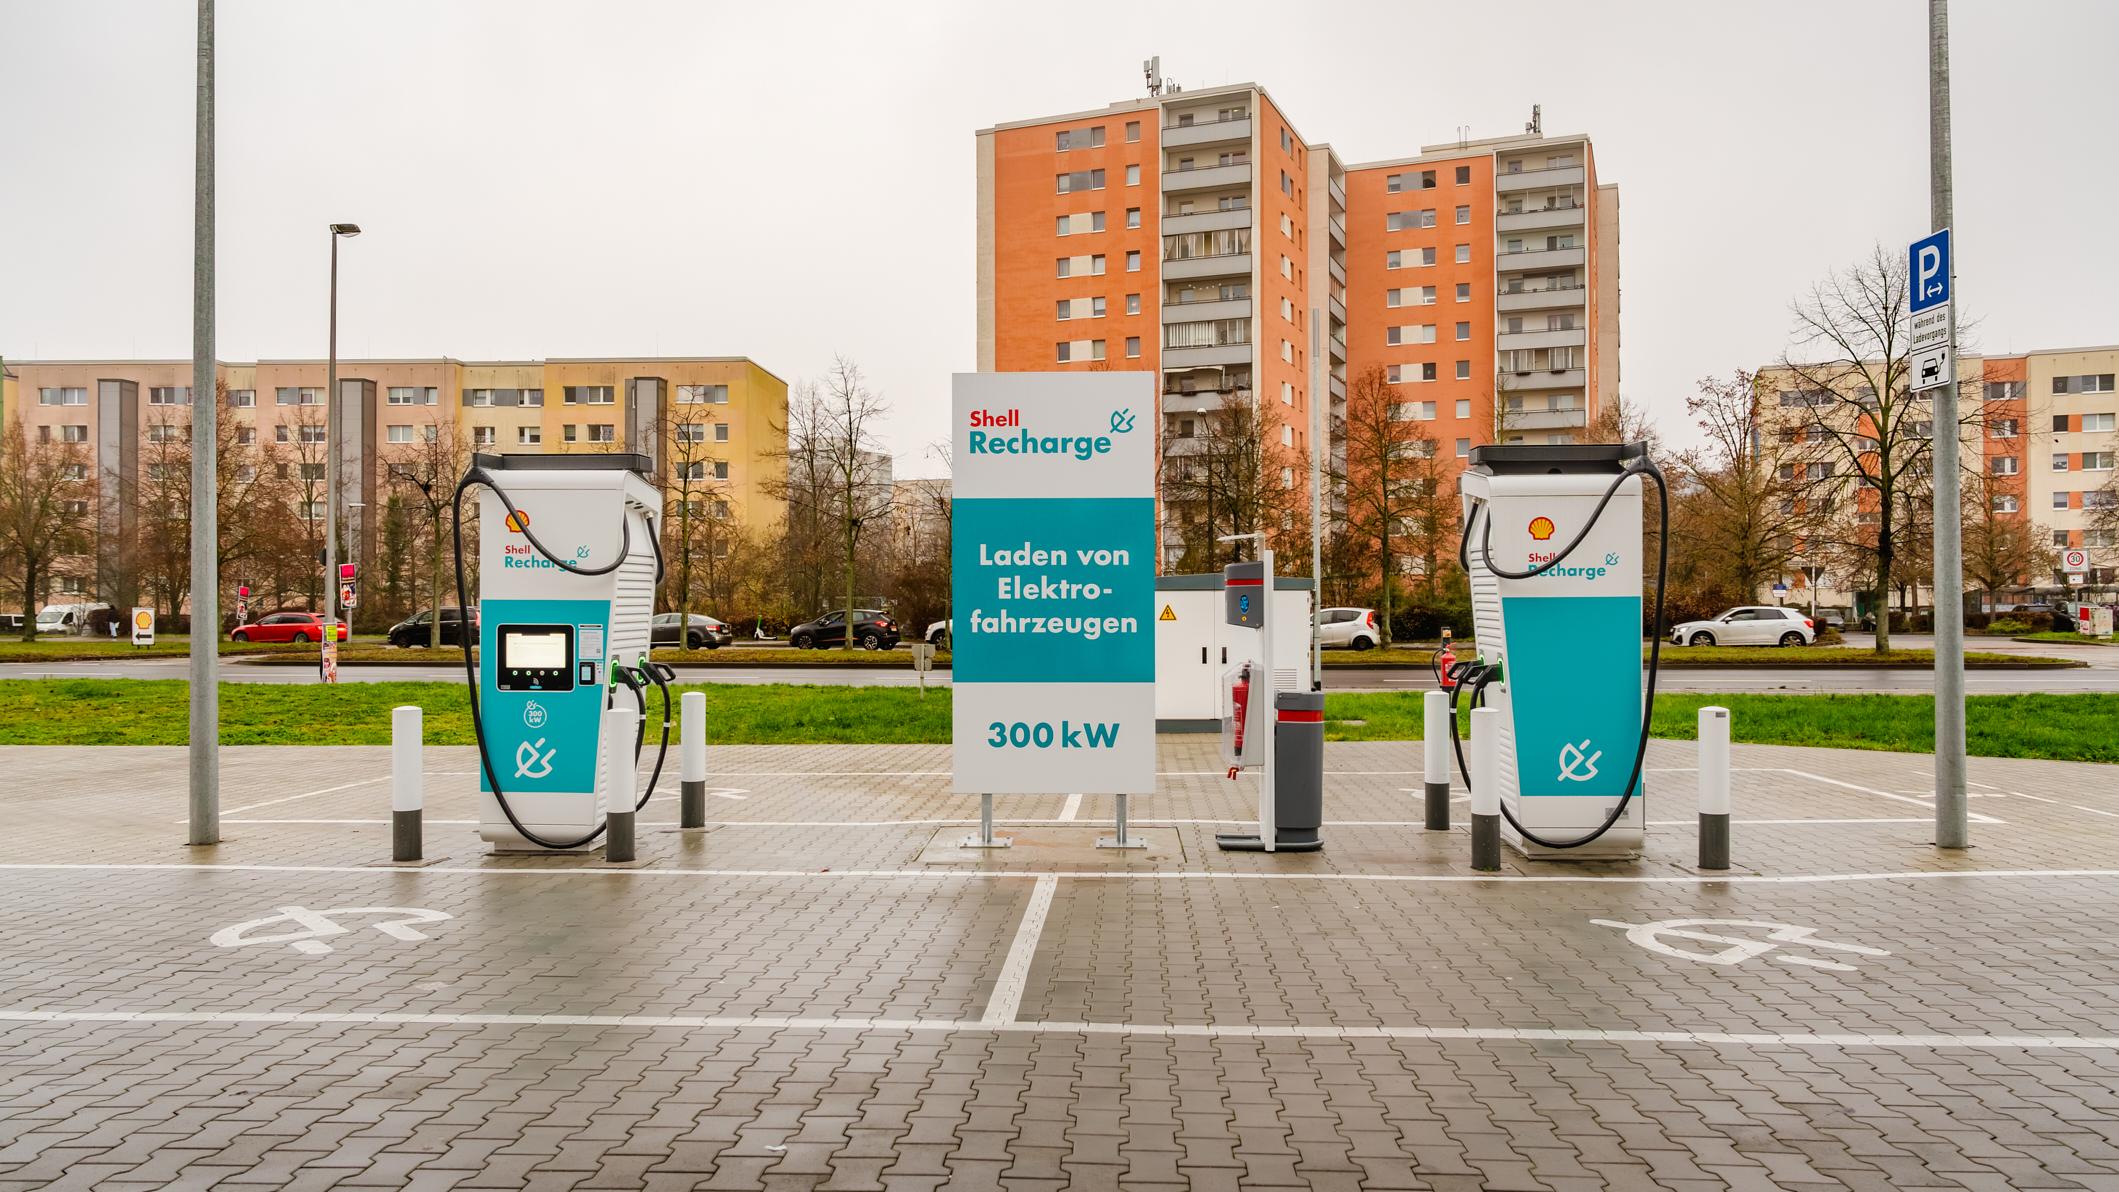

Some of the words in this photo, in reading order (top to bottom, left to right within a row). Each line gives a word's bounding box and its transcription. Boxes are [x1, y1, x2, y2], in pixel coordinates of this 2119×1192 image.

[1919, 245, 1940, 301] P
[1914, 314, 1935, 329] während
[1936, 312, 1946, 323] des
[1913, 327, 1947, 345] Ladevorgangs
[969, 409, 1019, 427] Shell
[969, 428, 1112, 461] Recharge
[505, 545, 531, 555] Shell
[979, 541, 1068, 567] Laden
[1076, 549, 1130, 567] von
[2071, 555, 2081, 563] 30
[998, 575, 1113, 600] Elektro-
[970, 608, 1138, 640] fahrzeugen
[987, 721, 1055, 749] 300
[1061, 720, 1121, 748] kW
